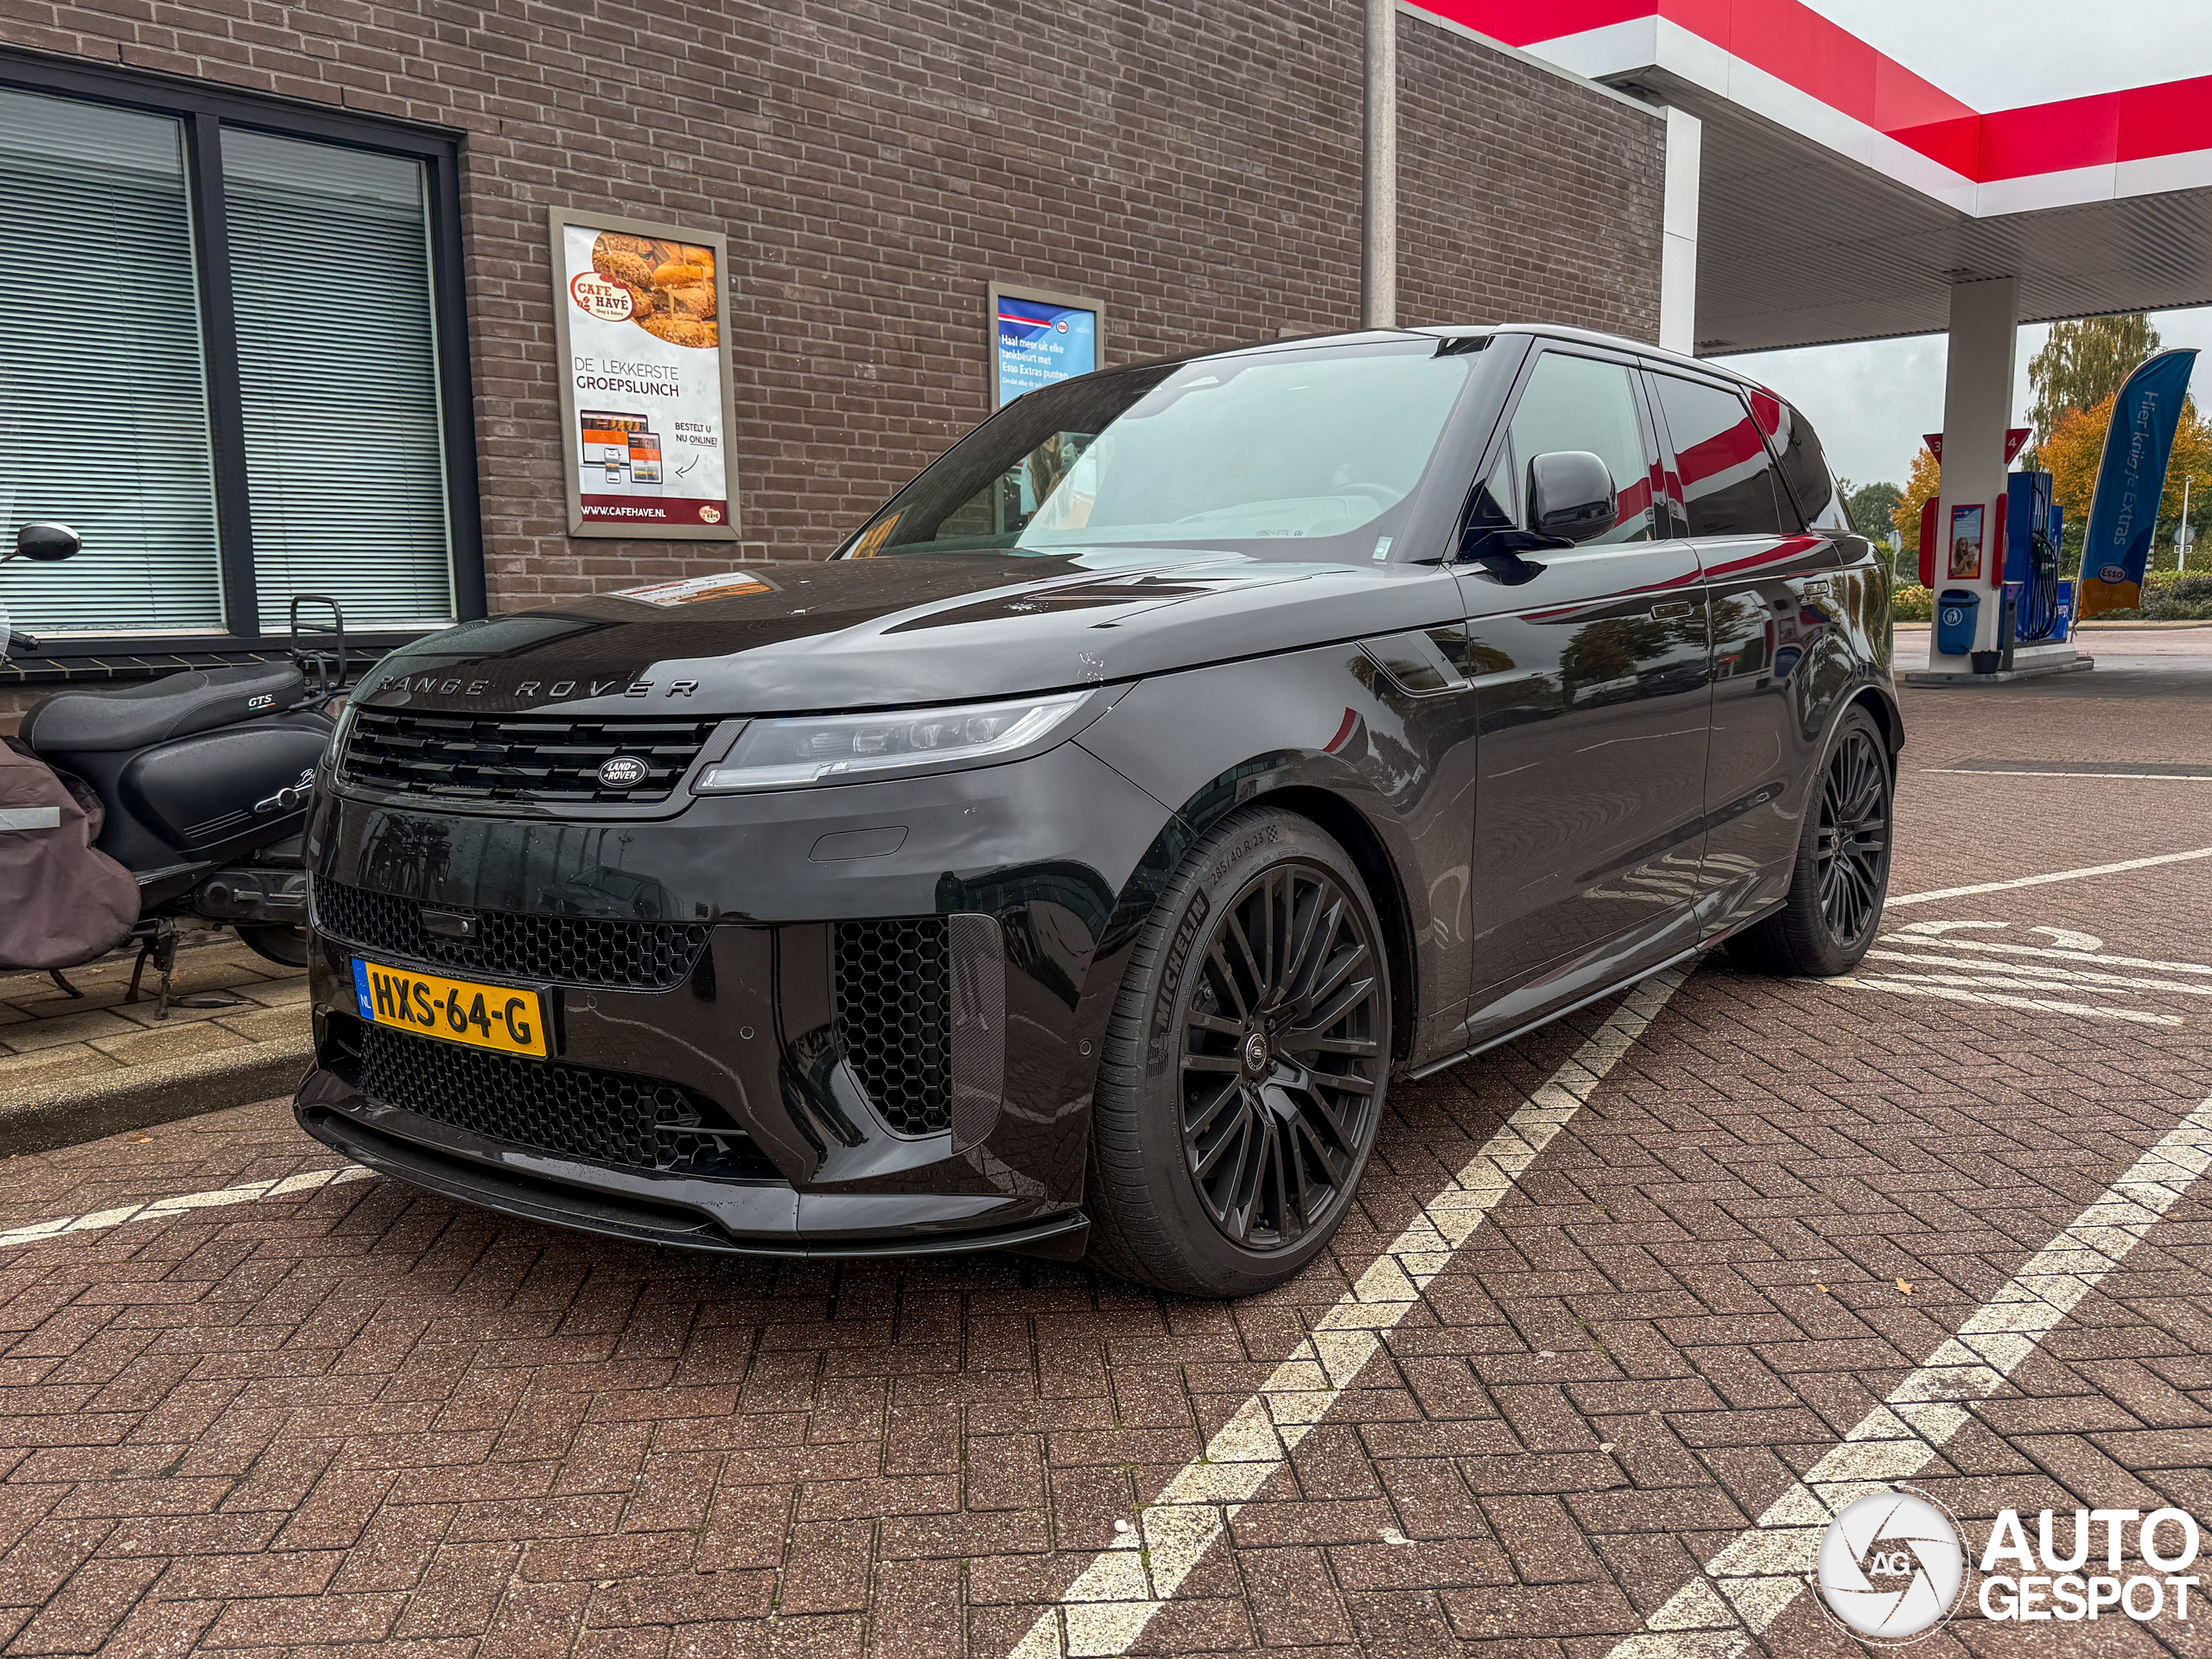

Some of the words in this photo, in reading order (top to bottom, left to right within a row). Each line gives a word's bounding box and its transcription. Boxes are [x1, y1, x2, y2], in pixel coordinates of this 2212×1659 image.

[578, 283, 612, 296] CAFE
[595, 296, 628, 310] HAVÉ
[1001, 334, 1018, 346] Haal
[1020, 340, 1037, 350] meer
[1039, 340, 1048, 352] uit
[1050, 342, 1064, 353] elke
[1001, 349, 1037, 363] tankbeurt
[1038, 356, 1052, 365] met
[575, 357, 594, 372] DE
[602, 359, 679, 380] LEKKERSTE
[1002, 362, 1018, 373] Esso
[1020, 364, 1042, 377] Extras
[576, 376, 679, 397] GROEPSLUNCH
[2137, 391, 2158, 429] Hier
[675, 422, 703, 433] BESTELT
[706, 424, 712, 433] U
[676, 434, 688, 442] NU
[690, 435, 717, 446] ONLINE!
[1934, 442, 1942, 452] 3
[2008, 436, 2017, 448] 4
[2126, 431, 2150, 469] krijg
[2125, 468, 2139, 487] je
[581, 506, 666, 518] WWW.CAFEHAVE.NL
[2113, 492, 2136, 545] Extras
[2101, 568, 2123, 579] Esso
[2092, 591, 2124, 601] extras
[377, 676, 491, 696] RANGE
[515, 678, 699, 698] ROVER
[248, 694, 272, 708] GTS
[607, 762, 632, 772] LAND
[608, 771, 637, 781] ROVER
[1211, 847, 1243, 886] 285/40
[1243, 840, 1251, 852] R
[1253, 833, 1264, 847] 23
[1155, 894, 1207, 1028] MICHELIN
[360, 994, 372, 1009] NL
[372, 971, 531, 1045] HXS-64-G
